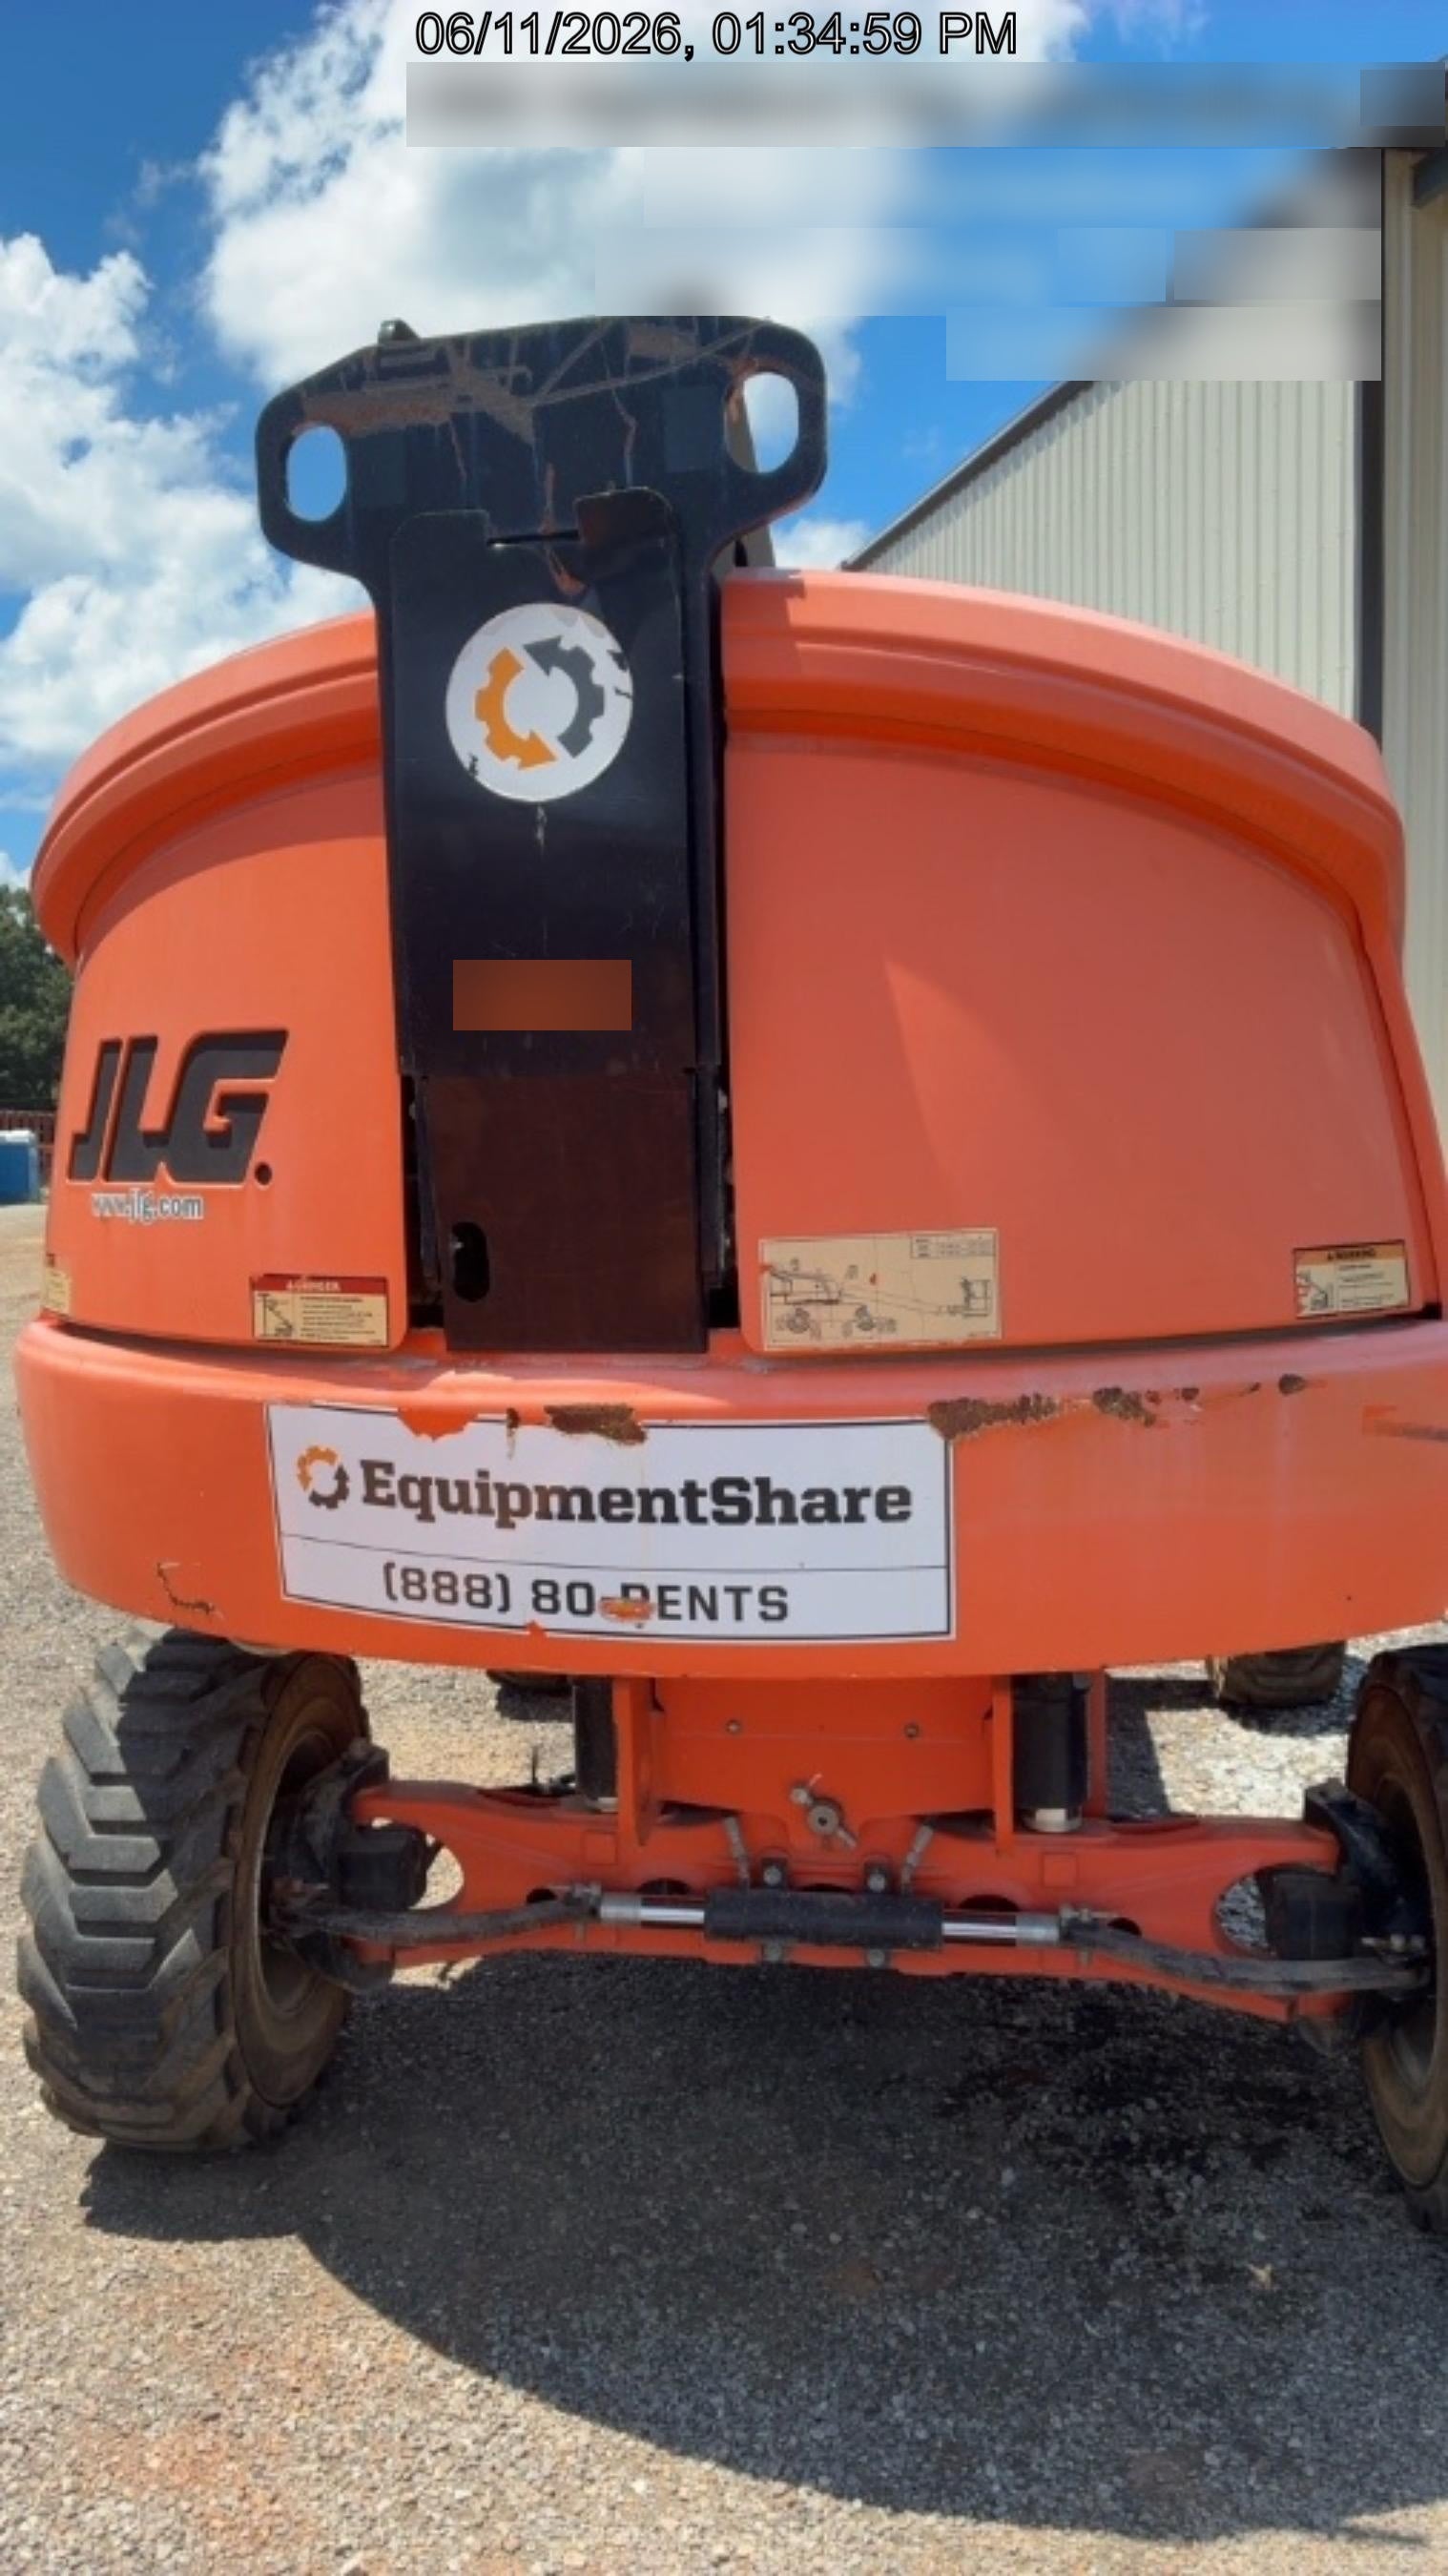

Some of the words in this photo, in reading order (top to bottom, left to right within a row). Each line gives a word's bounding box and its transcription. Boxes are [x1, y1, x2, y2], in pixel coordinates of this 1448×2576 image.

[92, 1189, 204, 1226] www.jlg.com
[360, 1459, 914, 1529] EquipmentShare
[383, 1561, 511, 1612] (888)
